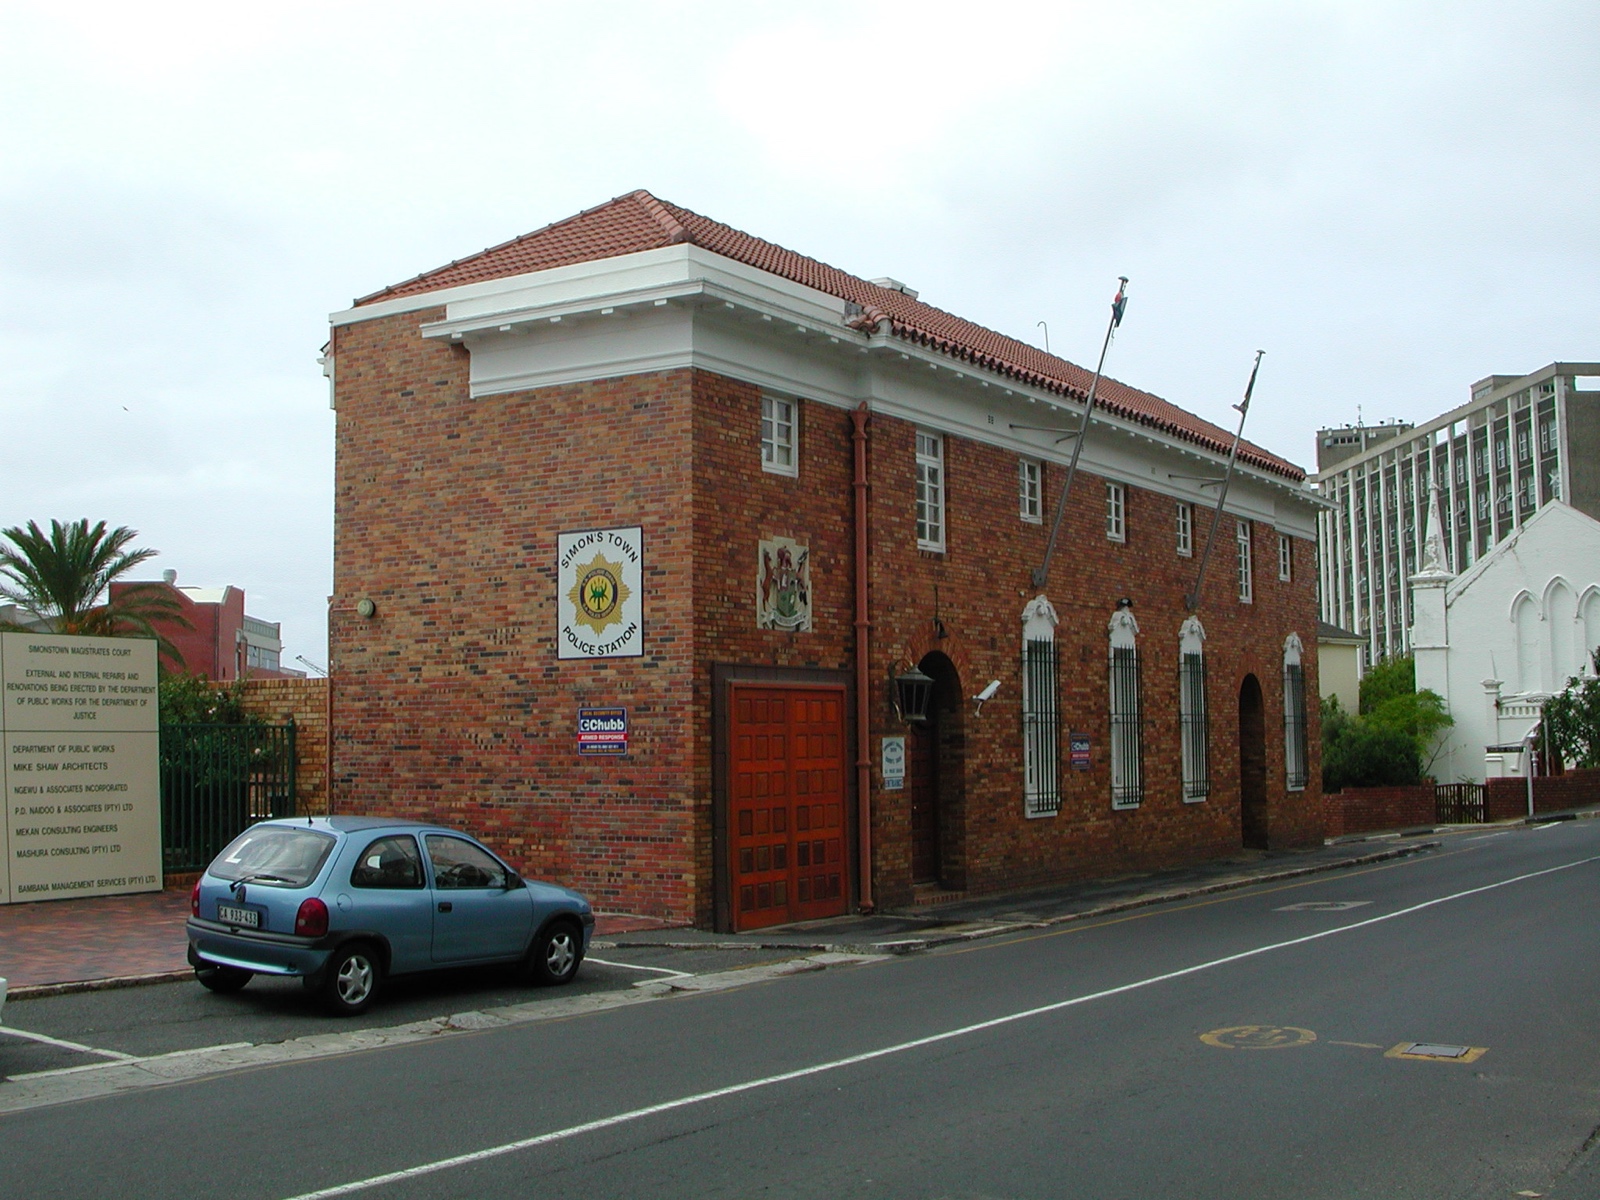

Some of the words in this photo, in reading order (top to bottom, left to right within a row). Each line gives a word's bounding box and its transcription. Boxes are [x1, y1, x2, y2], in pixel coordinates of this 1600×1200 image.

[561, 531, 604, 569] SIMON'S
[607, 532, 639, 563] TOWN
[562, 625, 596, 655] POLICE
[597, 622, 638, 656] STATION
[28, 645, 69, 654] SIMONSTOWN
[71, 647, 110, 656] MAGISTRATES
[112, 648, 132, 656] COURT
[26, 669, 56, 678] EXTERNAL
[59, 670, 71, 679] AND
[73, 671, 100, 679] INTERNAL
[102, 672, 126, 680] REPAIRS
[6, 682, 48, 692] RENOVATIONS
[50, 683, 69, 692] BEING
[70, 684, 97, 693] ERECTED
[98, 685, 106, 693] BY
[108, 685, 119, 693] THE
[120, 685, 156, 694] DEPARTMENT
[17, 697, 25, 705] OF
[27, 697, 49, 706] PUBLIC
[51, 697, 73, 706] WORKS
[75, 698, 87, 706] FOR
[89, 698, 100, 706] THE
[102, 698, 138, 707] DEPARTMENT
[140, 699, 148, 707] OF
[73, 711, 96, 720] JUSTICE
[589, 718, 625, 731] Chubb
[12, 745, 55, 753] DEPARTMENT
[58, 745, 66, 753] OF
[68, 745, 90, 753] PUBLIC
[92, 745, 115, 753] WORKS
[13, 763, 33, 771] MIKE
[36, 762, 59, 771] SHAW
[61, 762, 108, 770] ARCHITECTS
[40, 786, 44, 794] &
[46, 785, 83, 793] ASSOCIATES
[85, 783, 128, 792] INCORPORATED
[29, 806, 54, 814] NAIDOO
[57, 805, 61, 813] &
[64, 804, 102, 813] ASSOCIATES
[104, 803, 121, 812] (PTY)
[122, 803, 133, 811] LTD
[16, 827, 40, 836] MEKAN
[41, 825, 81, 835] CONSULTING
[83, 824, 118, 833] ENGINEERS
[16, 849, 48, 858] MASHURA
[51, 846, 90, 856] CONSULTING
[91, 845, 108, 854] (PTY)
[110, 844, 121, 852] LTD
[18, 883, 49, 893] BAMBANA
[51, 880, 94, 891] MANAGEMENT
[97, 877, 126, 888] SERVICES
[128, 876, 144, 885] (PTY)
[220, 907, 228, 920] CA
[230, 909, 257, 925] 933-433
